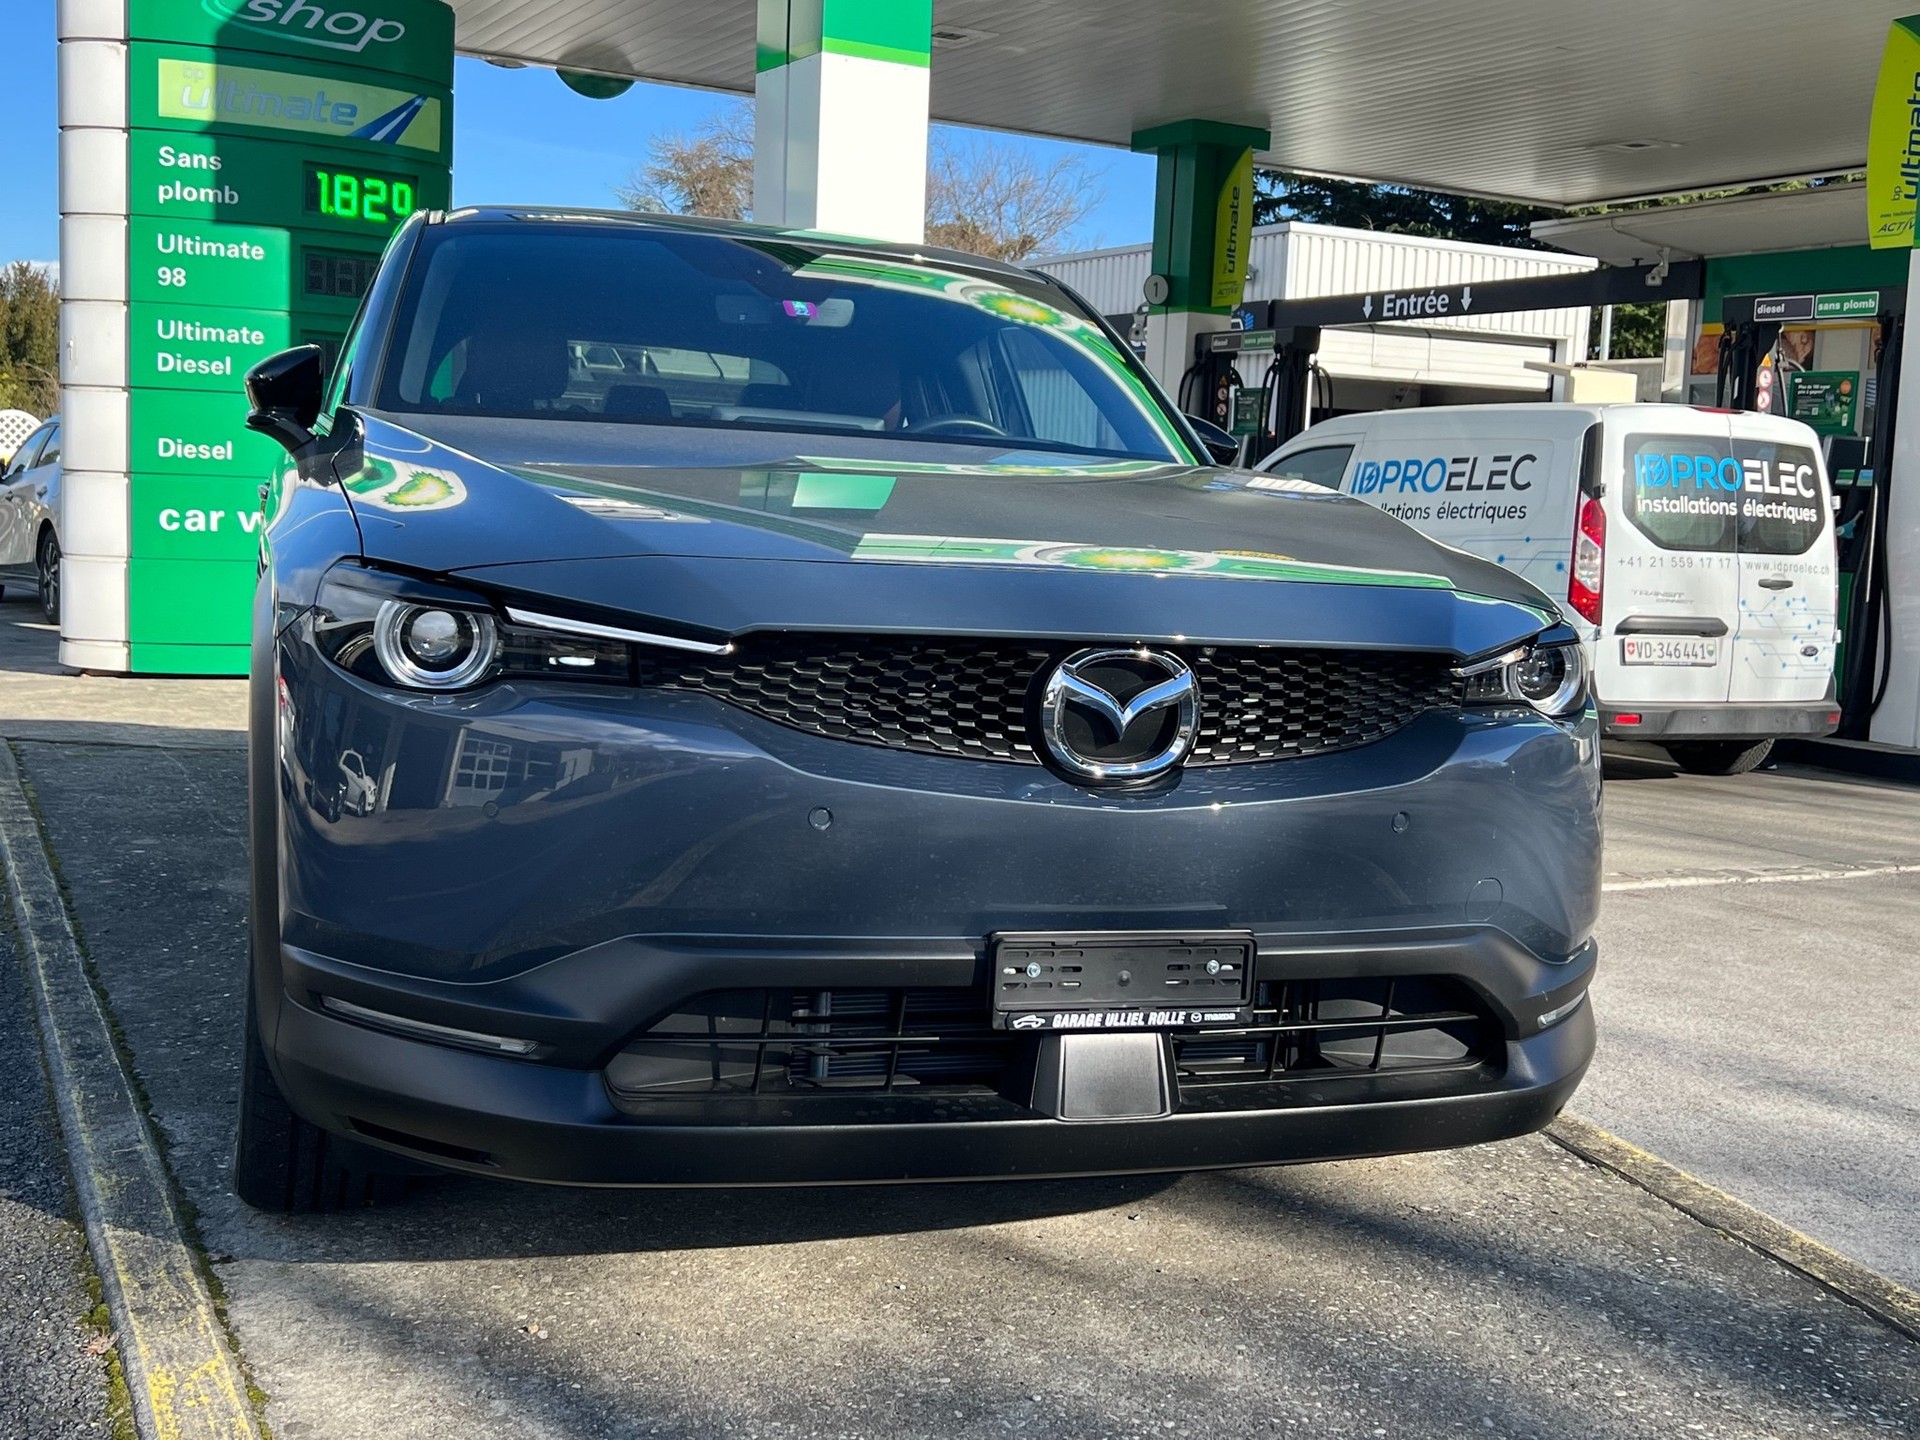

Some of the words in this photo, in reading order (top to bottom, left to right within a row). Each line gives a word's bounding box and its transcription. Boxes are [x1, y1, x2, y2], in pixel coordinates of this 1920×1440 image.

[237, 0, 406, 52] shop
[181, 80, 358, 126] ultimate
[158, 145, 222, 170] Sans
[158, 180, 239, 204] plomb
[1891, 185, 1903, 202] bp
[1226, 185, 1240, 274] ultimate
[157, 233, 265, 261] Ultimate
[157, 266, 187, 287] 98
[1153, 281, 1159, 298] 1
[1382, 289, 1449, 317] Entrée
[1757, 303, 1785, 314] diesel
[1818, 301, 1840, 311] sans
[1843, 299, 1875, 311] plomb
[157, 319, 265, 346] Ultimate
[157, 352, 232, 375] Diesel
[157, 437, 233, 460] Diesel
[1351, 453, 1538, 495] IDPROELEC
[1634, 453, 1816, 499] IDPROELEC
[158, 508, 225, 532] car
[1436, 500, 1528, 524] électriques
[1637, 495, 1738, 516] installations
[1743, 498, 1817, 524] électriques
[1618, 557, 1643, 568] +41
[1650, 556, 1665, 568] 21
[1671, 557, 1694, 568] 559
[1700, 557, 1713, 568] 17
[1719, 557, 1731, 568] 17
[1745, 559, 1830, 576] www.idproelec.ch
[1052, 1013, 1103, 1028] GARAGE
[1105, 1012, 1144, 1027] ULLIEL
[1149, 1011, 1186, 1026] ROLLE
